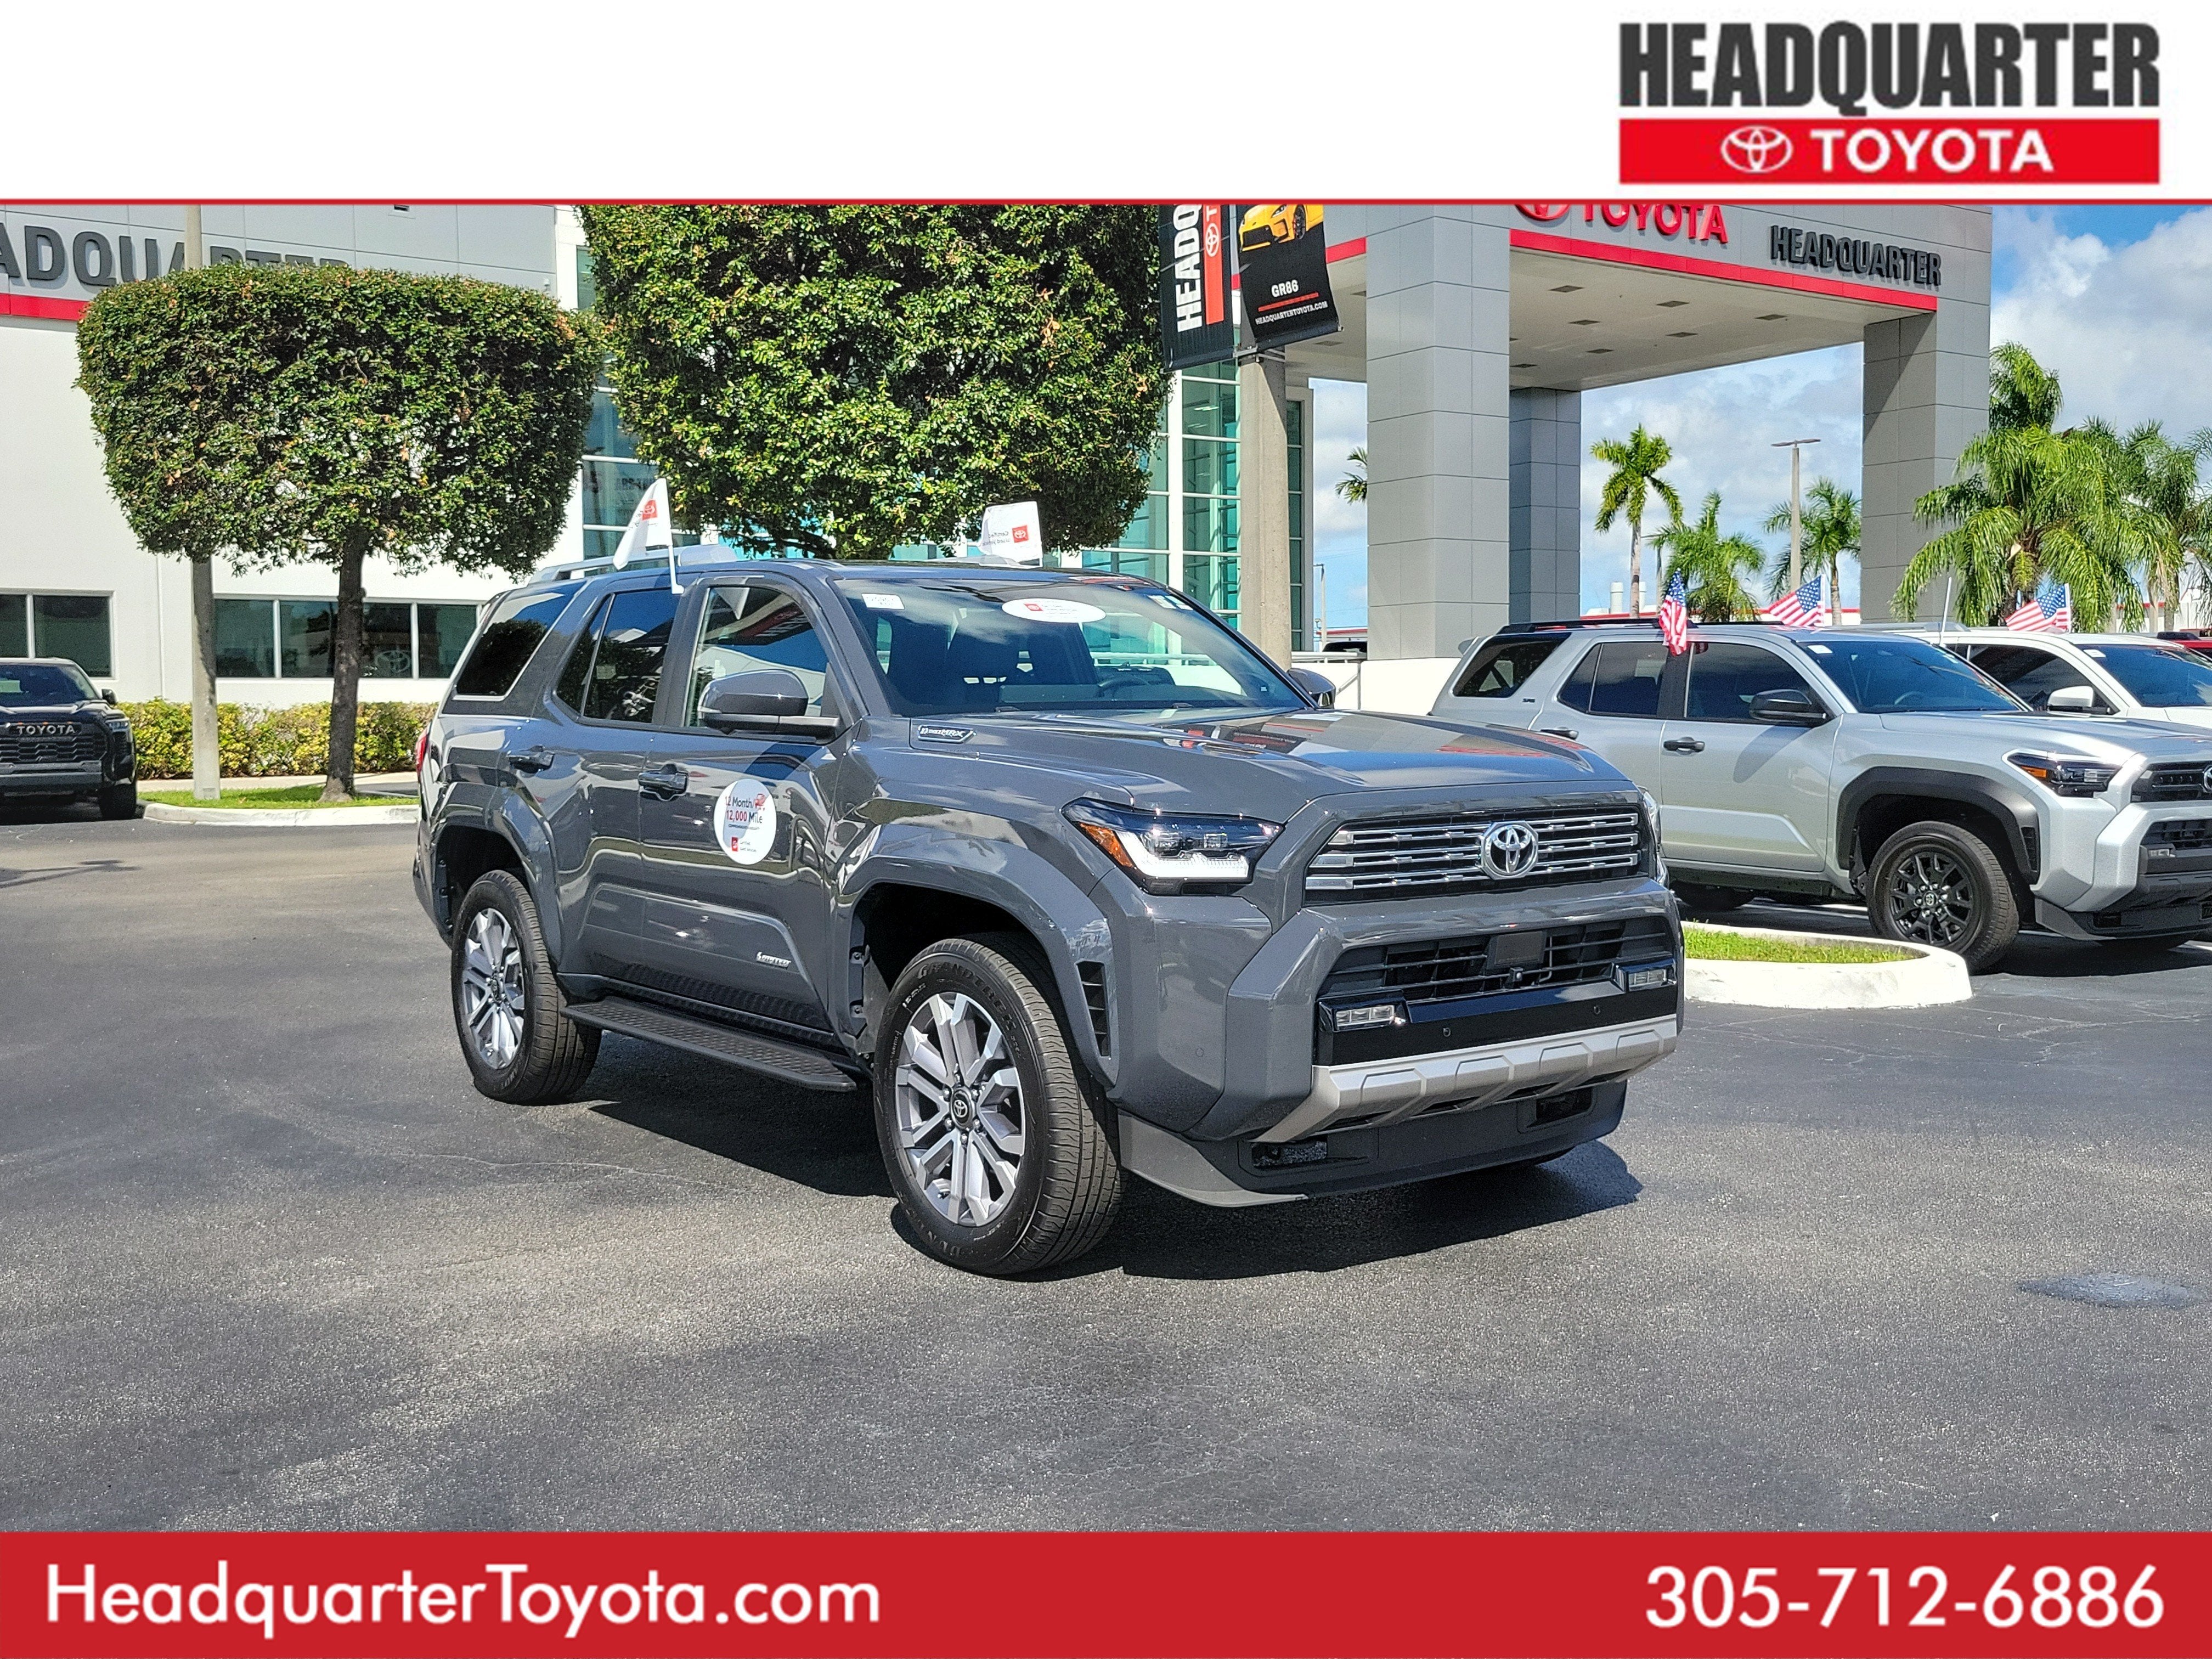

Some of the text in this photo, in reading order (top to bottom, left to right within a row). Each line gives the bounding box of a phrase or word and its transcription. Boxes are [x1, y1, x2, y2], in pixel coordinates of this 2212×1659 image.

[1770, 225, 1942, 281] HEADQUARTER
[1271, 279, 1299, 297] GR86
[1255, 301, 1328, 325] HEADQUARTERTOYOTA.COM
[16, 724, 76, 735] TOYOTA
[726, 809, 763, 824] 12,000 Mile
